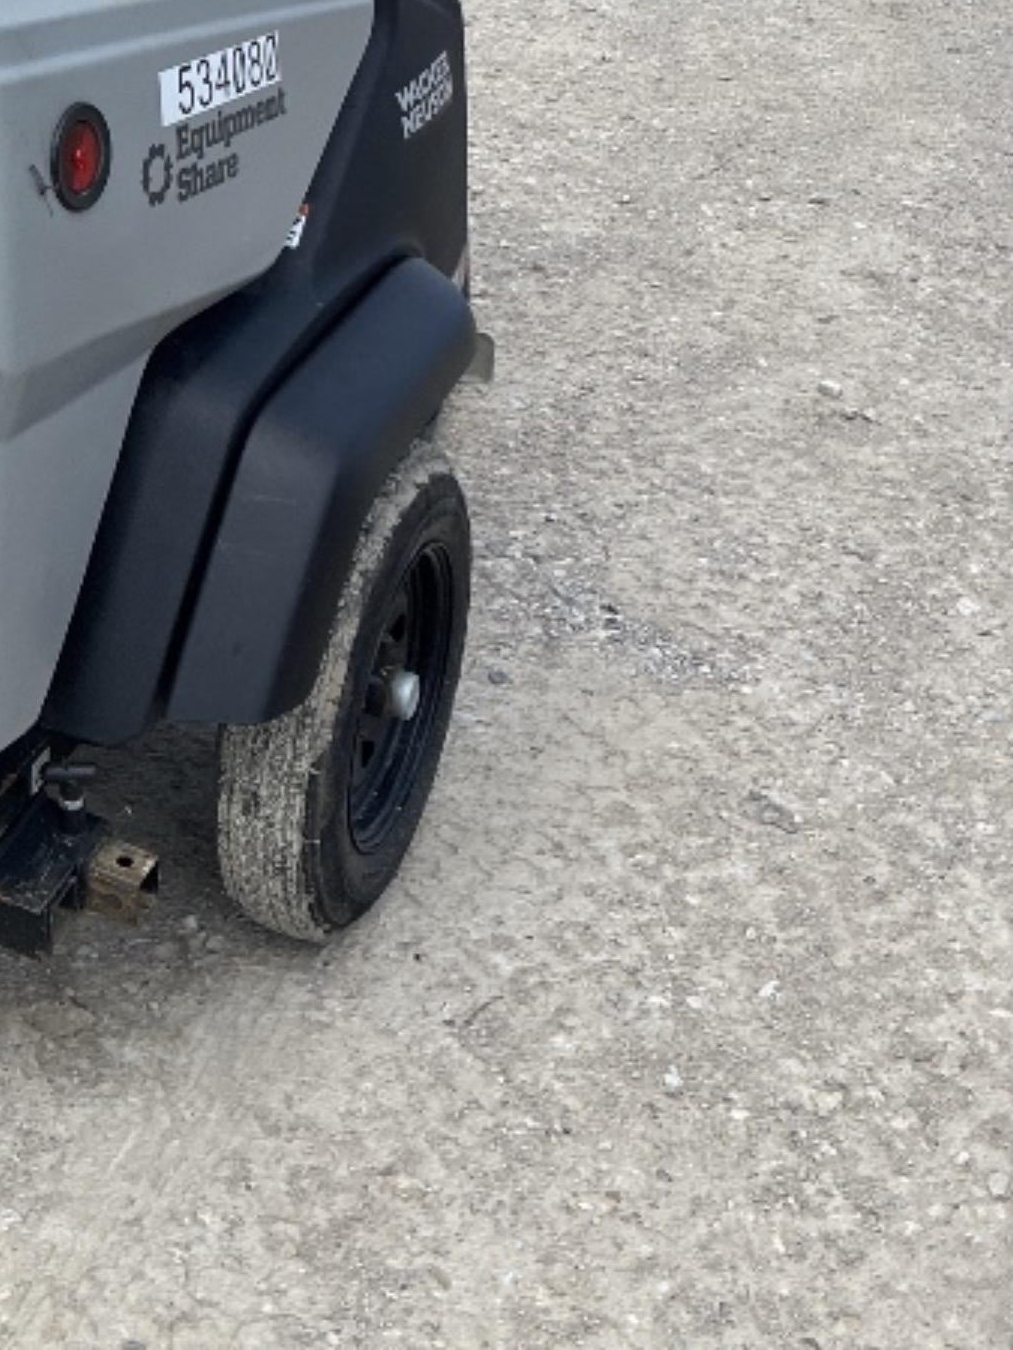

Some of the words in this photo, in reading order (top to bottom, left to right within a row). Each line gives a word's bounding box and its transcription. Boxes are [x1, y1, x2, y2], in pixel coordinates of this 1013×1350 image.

[178, 34, 277, 115] 534080
[394, 50, 450, 112] WACKER
[401, 72, 453, 139] NEUSON
[176, 86, 286, 160] Equipment
[177, 153, 239, 202] Share
